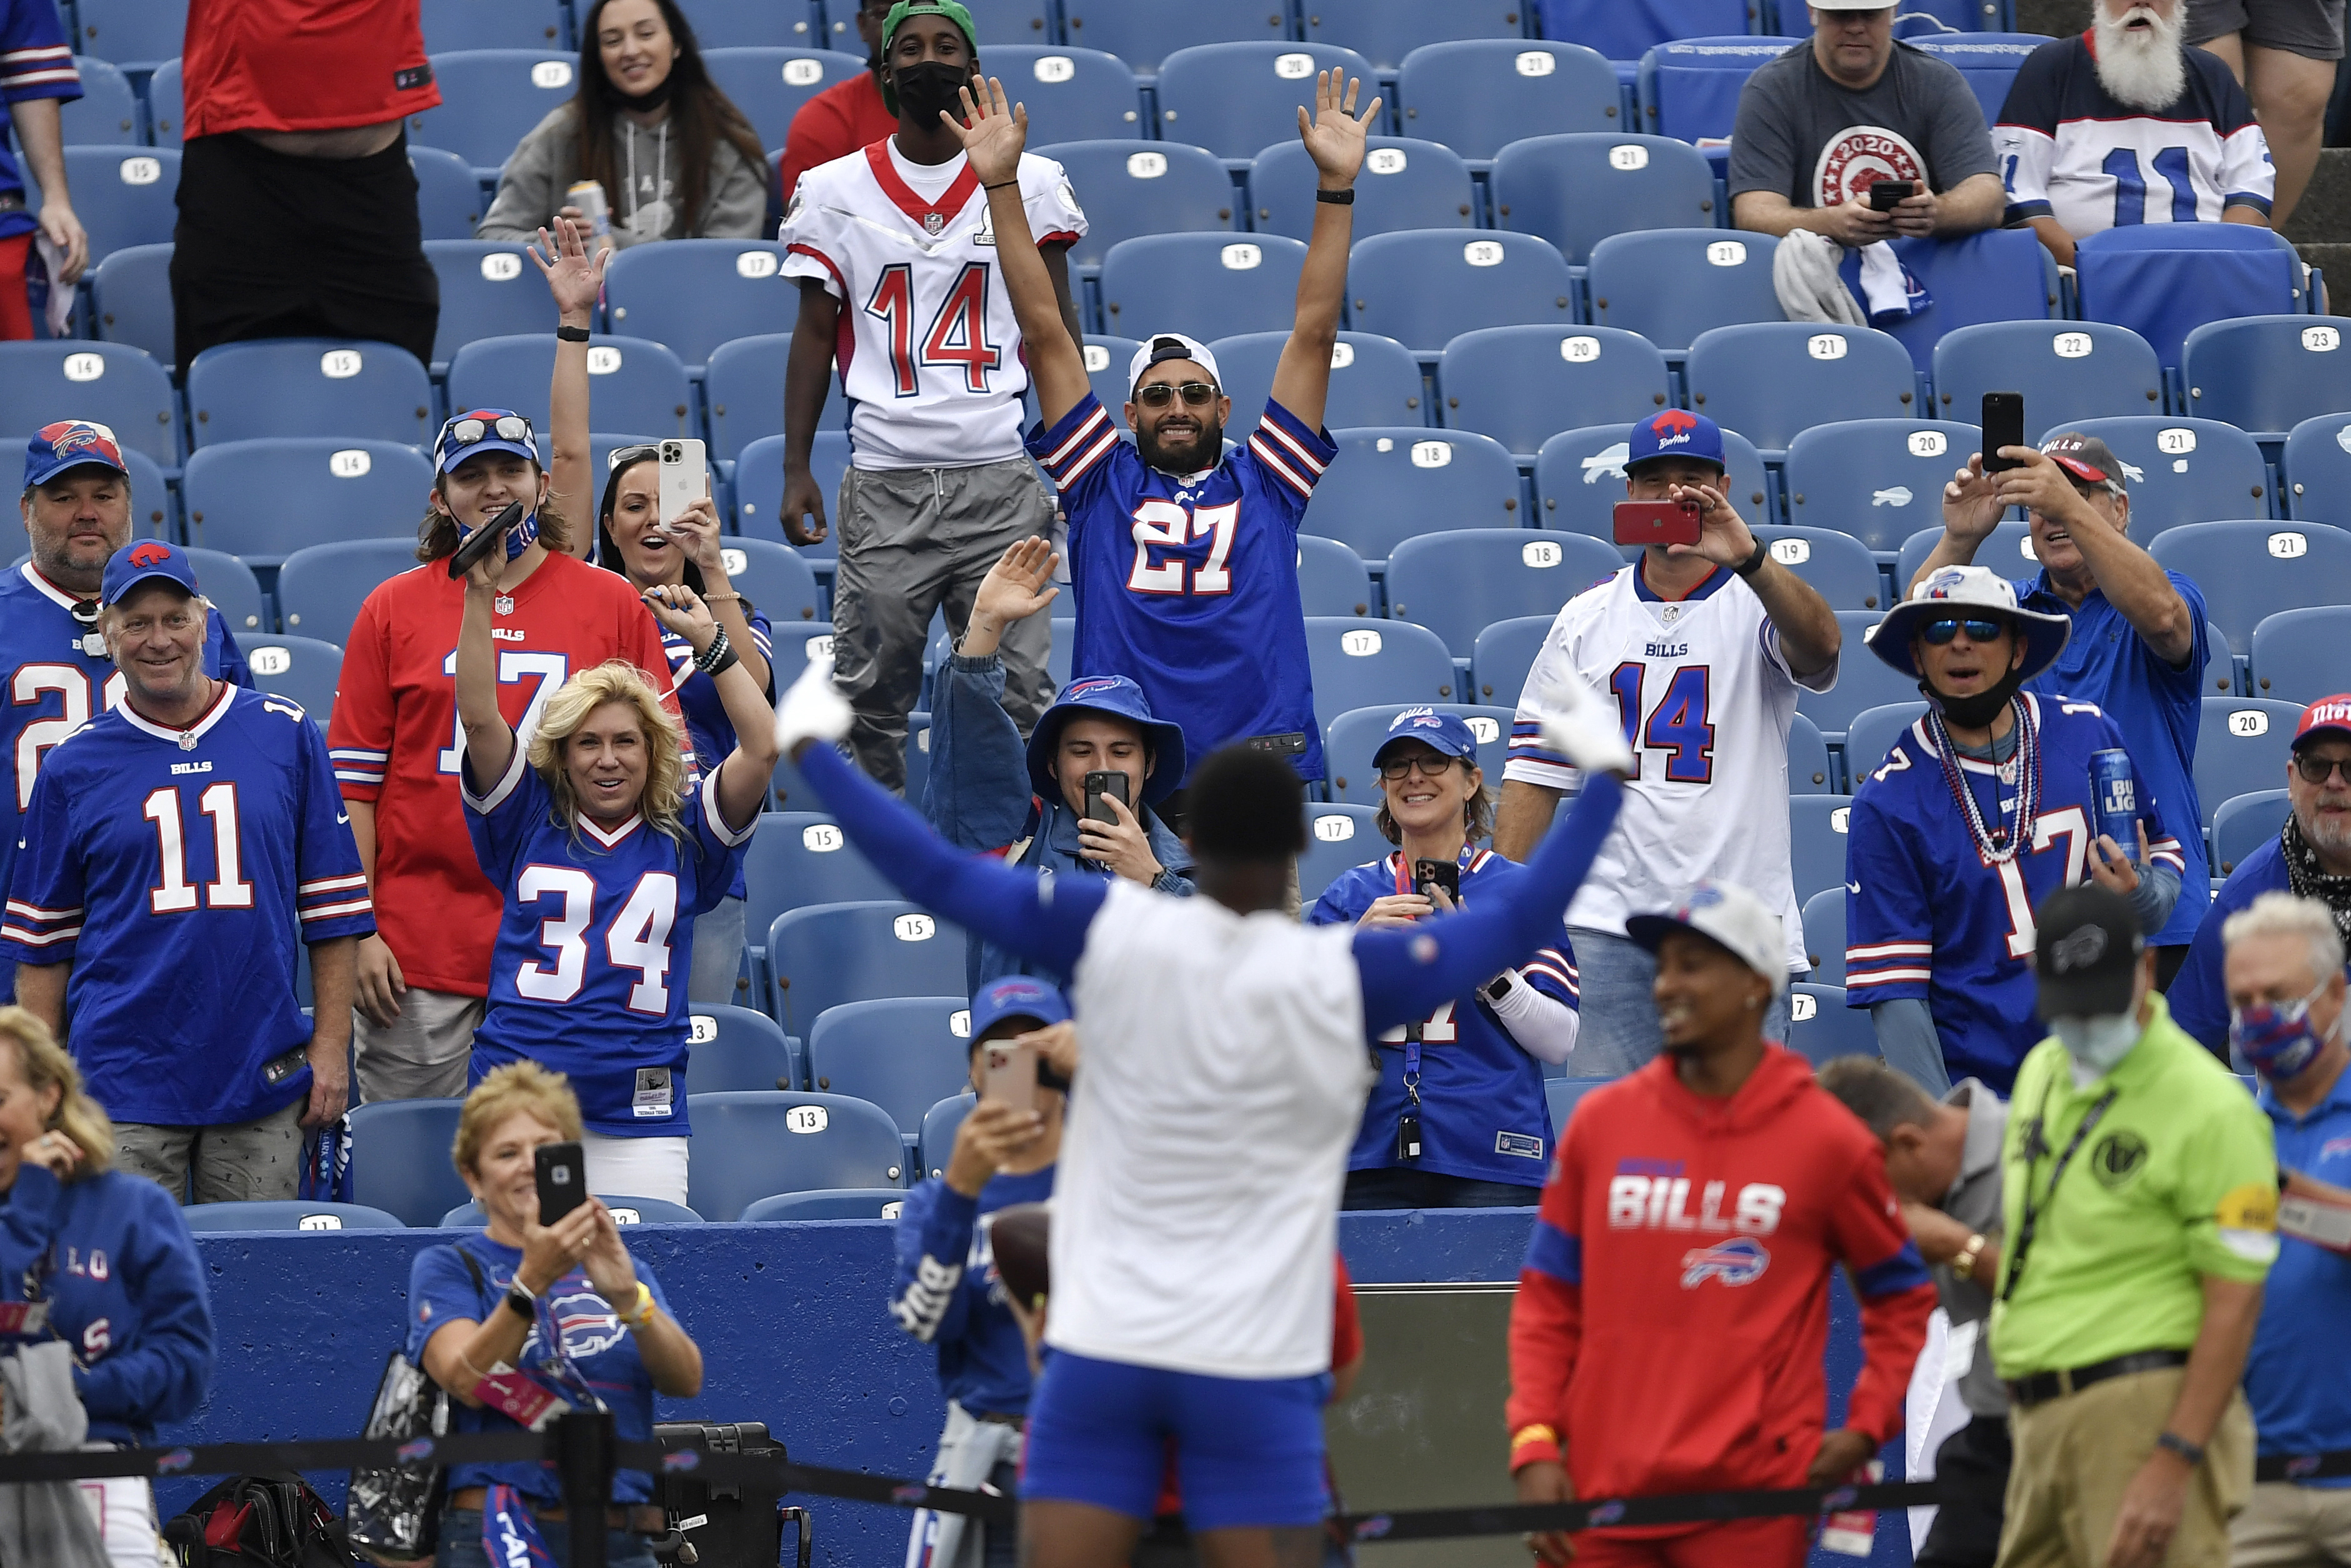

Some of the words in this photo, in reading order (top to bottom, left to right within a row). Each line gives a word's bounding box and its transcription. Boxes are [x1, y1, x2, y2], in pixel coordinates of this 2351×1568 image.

[1838, 136, 1895, 159] 2020
[1621, 151, 1637, 165] 21
[2102, 146, 2199, 227] 11
[1718, 247, 1734, 261] 21
[864, 261, 1001, 398] 14
[1818, 339, 1835, 354] 21
[2064, 338, 2081, 352] 22
[2311, 333, 2329, 347] 23
[1572, 342, 1589, 357] 20
[78, 361, 92, 374] 14
[334, 357, 349, 371] 15
[594, 354, 610, 367] 16
[1658, 432, 1690, 451] Buffalo
[1918, 437, 1936, 451] 20
[2168, 435, 2184, 449] 21
[1424, 447, 1440, 461] 18
[343, 457, 359, 472] 14
[1127, 497, 1241, 595] 27
[1782, 544, 1799, 559] 19
[2278, 539, 2295, 553] 21
[726, 555, 735, 569] 5
[1535, 548, 1552, 562] 18
[1354, 637, 1370, 652] 17
[1644, 643, 1689, 657] BILLS
[261, 656, 278, 670] 13
[437, 648, 569, 775] 17
[1389, 706, 1434, 732] Bills
[1610, 661, 1716, 785] 14
[2240, 716, 2257, 731] 20
[170, 761, 213, 776] BILLS
[2112, 779, 2134, 797] BU
[2105, 794, 2137, 814] LIG
[1843, 814, 1849, 828] 1
[1326, 822, 1342, 837] 17
[815, 831, 832, 846] 15
[143, 781, 255, 915] 11
[1977, 804, 2090, 961] 17
[906, 921, 923, 936] 15
[515, 862, 679, 1017] 34
[1795, 1000, 1805, 1015] 7
[962, 1017, 969, 1032] 1
[800, 1112, 816, 1128] 13
[1607, 1174, 1787, 1236] BILLS
